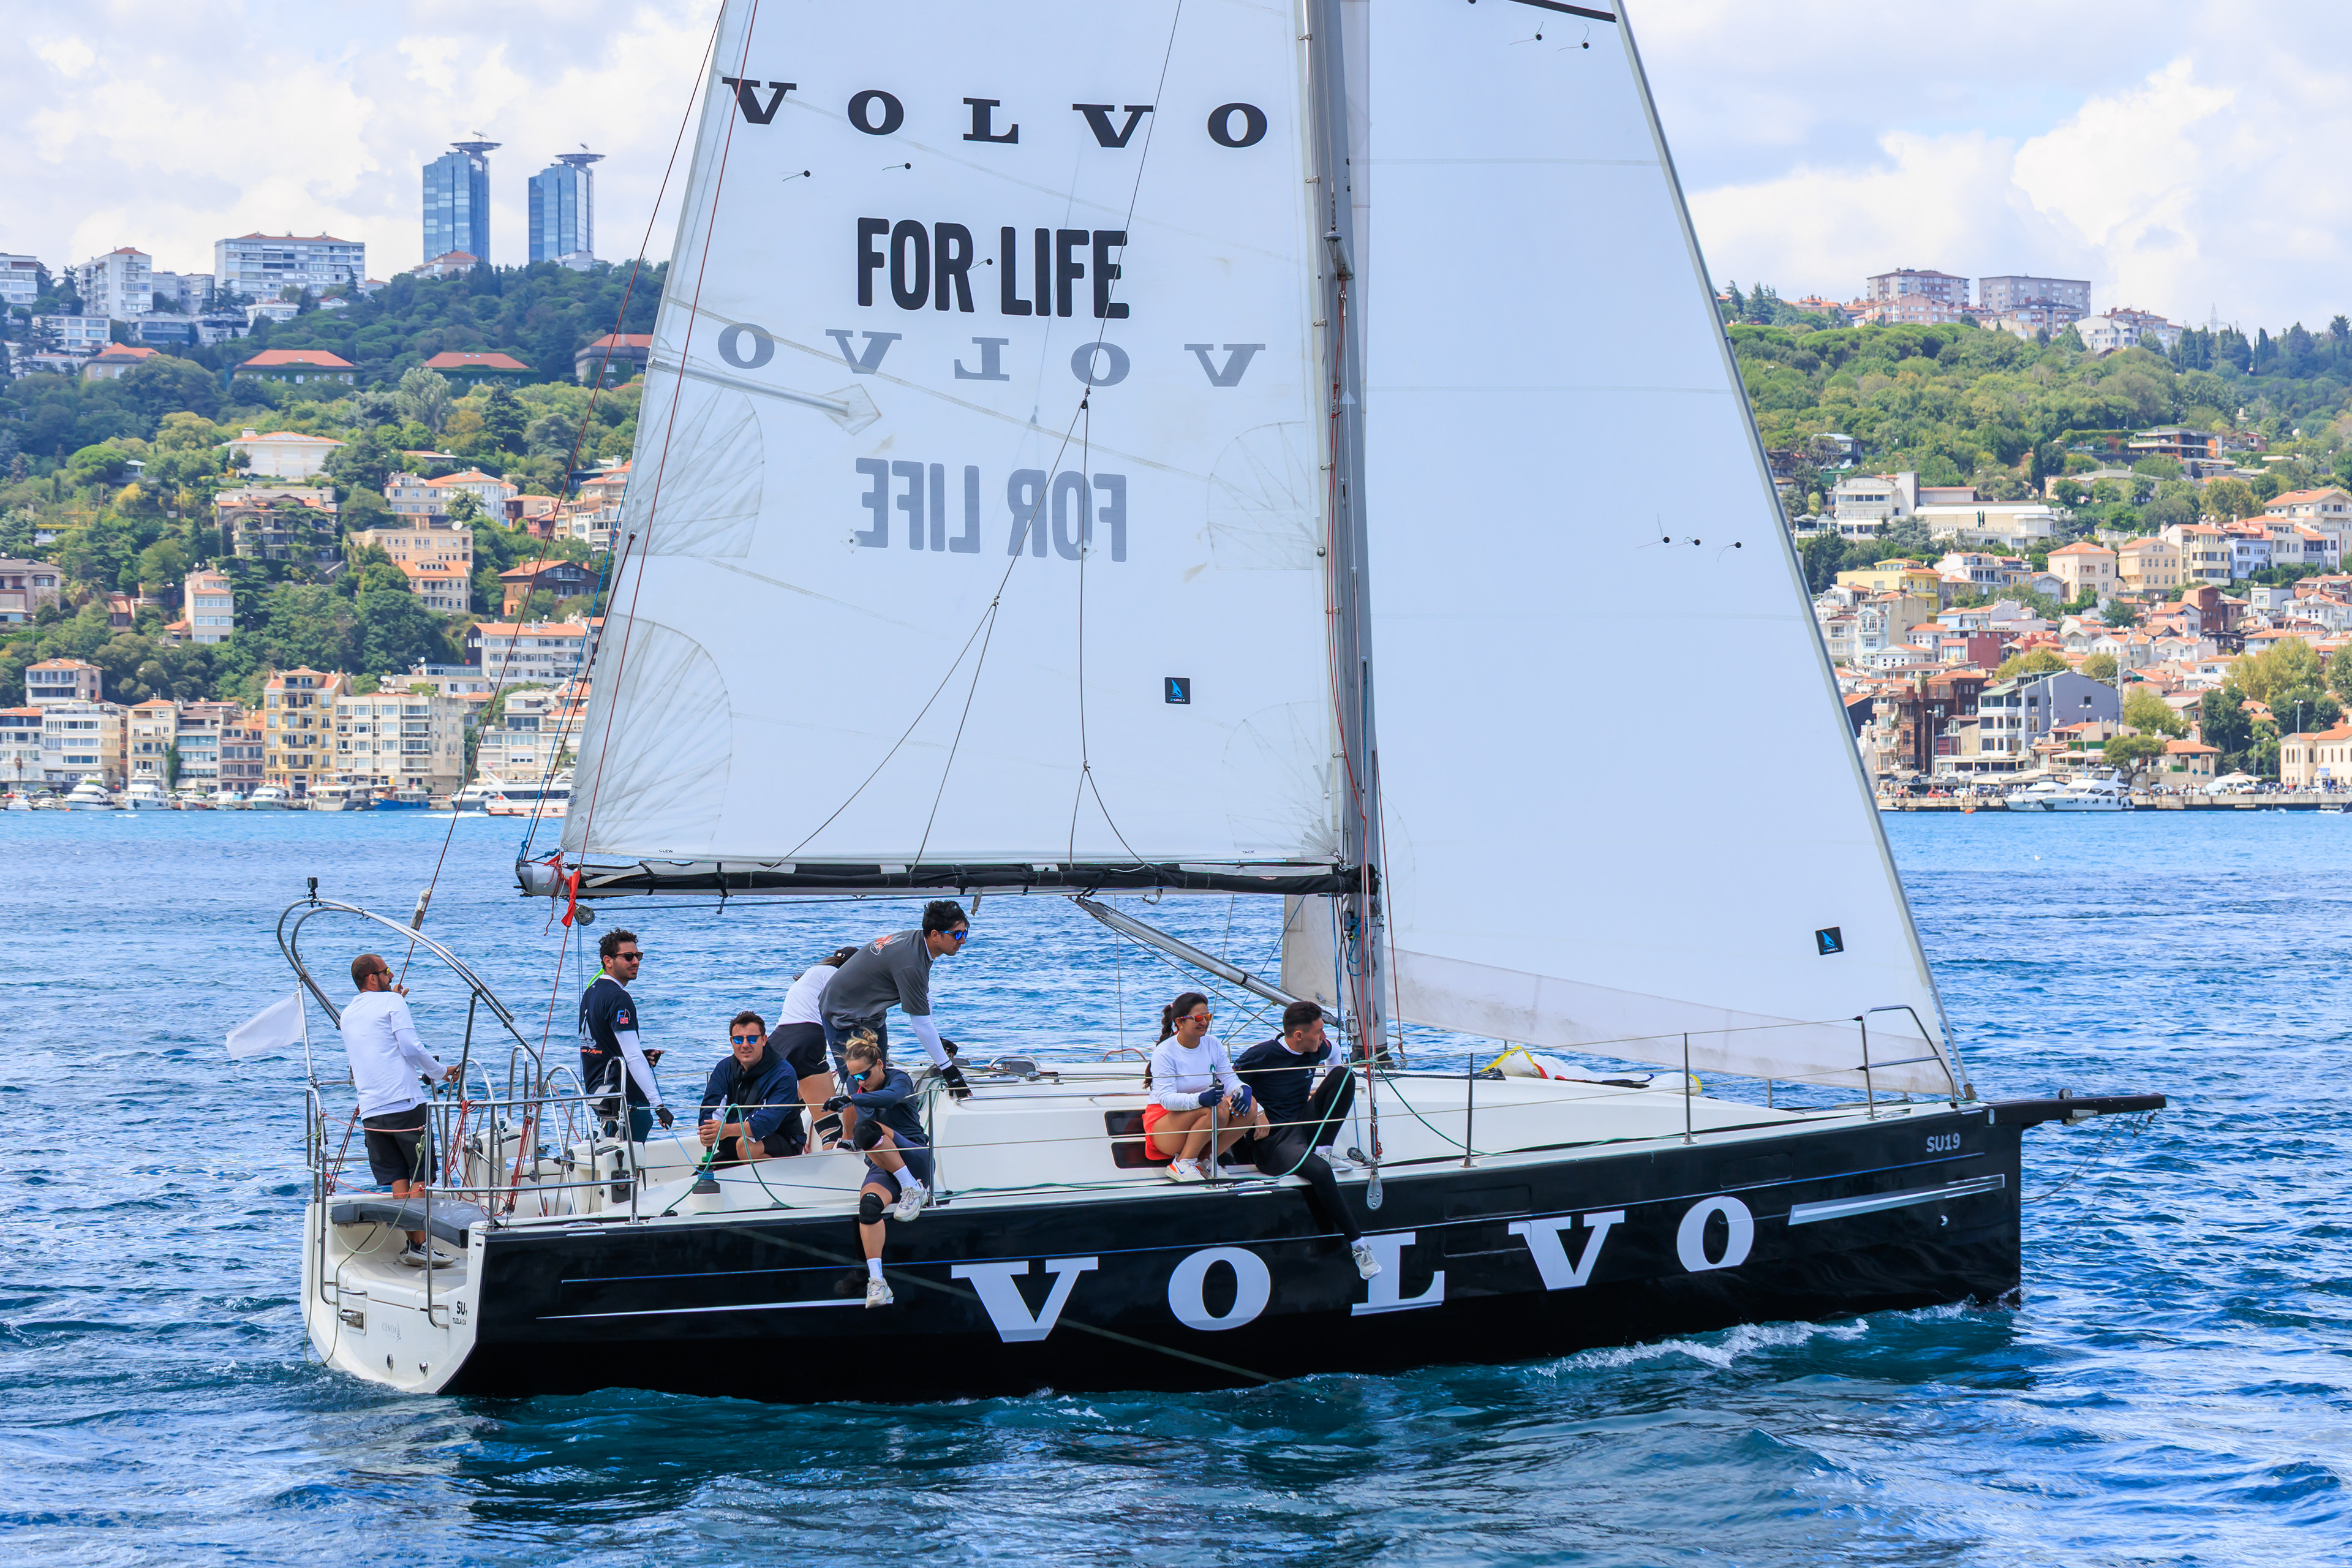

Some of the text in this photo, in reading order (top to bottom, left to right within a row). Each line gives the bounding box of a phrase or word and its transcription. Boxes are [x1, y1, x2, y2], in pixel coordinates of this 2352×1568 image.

[722, 77, 1267, 148] VOLVO
[858, 217, 1129, 319] FOR LIFE
[1926, 1133, 1961, 1153] SU19
[951, 1196, 1755, 1343] VOLVO
